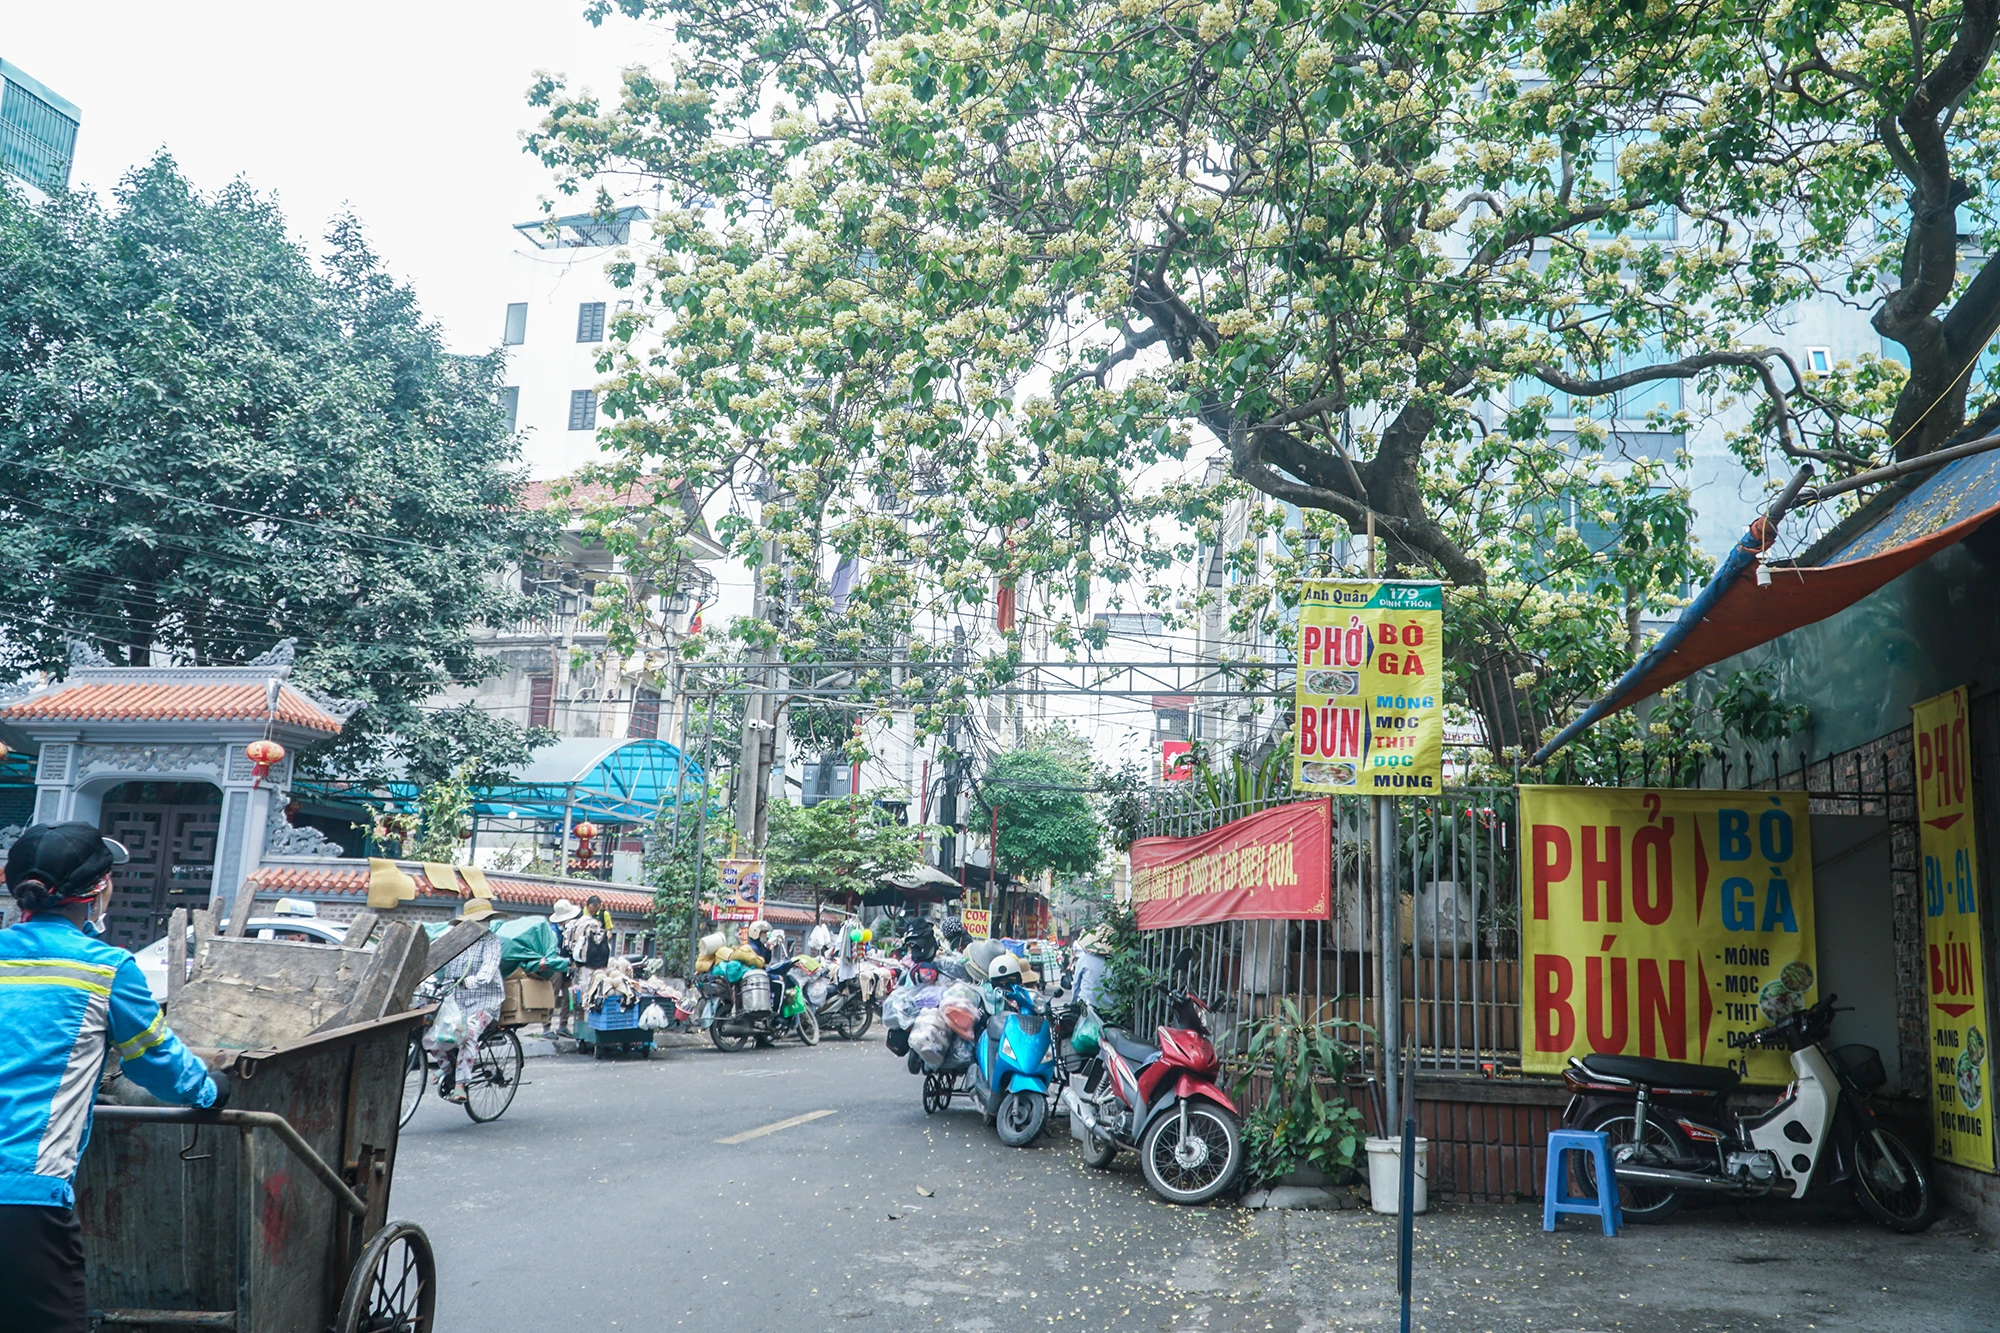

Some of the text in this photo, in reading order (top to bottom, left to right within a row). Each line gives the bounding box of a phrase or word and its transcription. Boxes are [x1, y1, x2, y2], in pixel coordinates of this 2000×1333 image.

[1304, 587, 1368, 604] Anh Quân
[1389, 588, 1419, 599] 179
[1404, 599, 1432, 608] THÔN
[1303, 615, 1364, 667] PHỞ
[1378, 619, 1424, 647] BÒ
[1378, 650, 1425, 676] GÀ
[1376, 695, 1433, 709] MÓNG
[1300, 698, 1361, 758] BÚN
[1376, 716, 1419, 731] MỌC
[1374, 735, 1417, 751] THỊT
[1918, 689, 1966, 812] PHỞ
[1374, 755, 1413, 770] DỌC
[1374, 773, 1433, 788] MÙNG
[1718, 796, 1794, 863] BÒ
[1266, 827, 1298, 891] QUẢ.
[1532, 793, 1675, 926] PHỞ
[1720, 866, 1798, 934] GÀ
[1724, 945, 1770, 967] MÓNG
[1929, 931, 1974, 996] BÚN
[1534, 934, 1688, 1061] BÚN
[1725, 975, 1759, 997] MỌC
[1726, 1002, 1758, 1026] THỊT
[1941, 1135, 1953, 1158] CÁ
